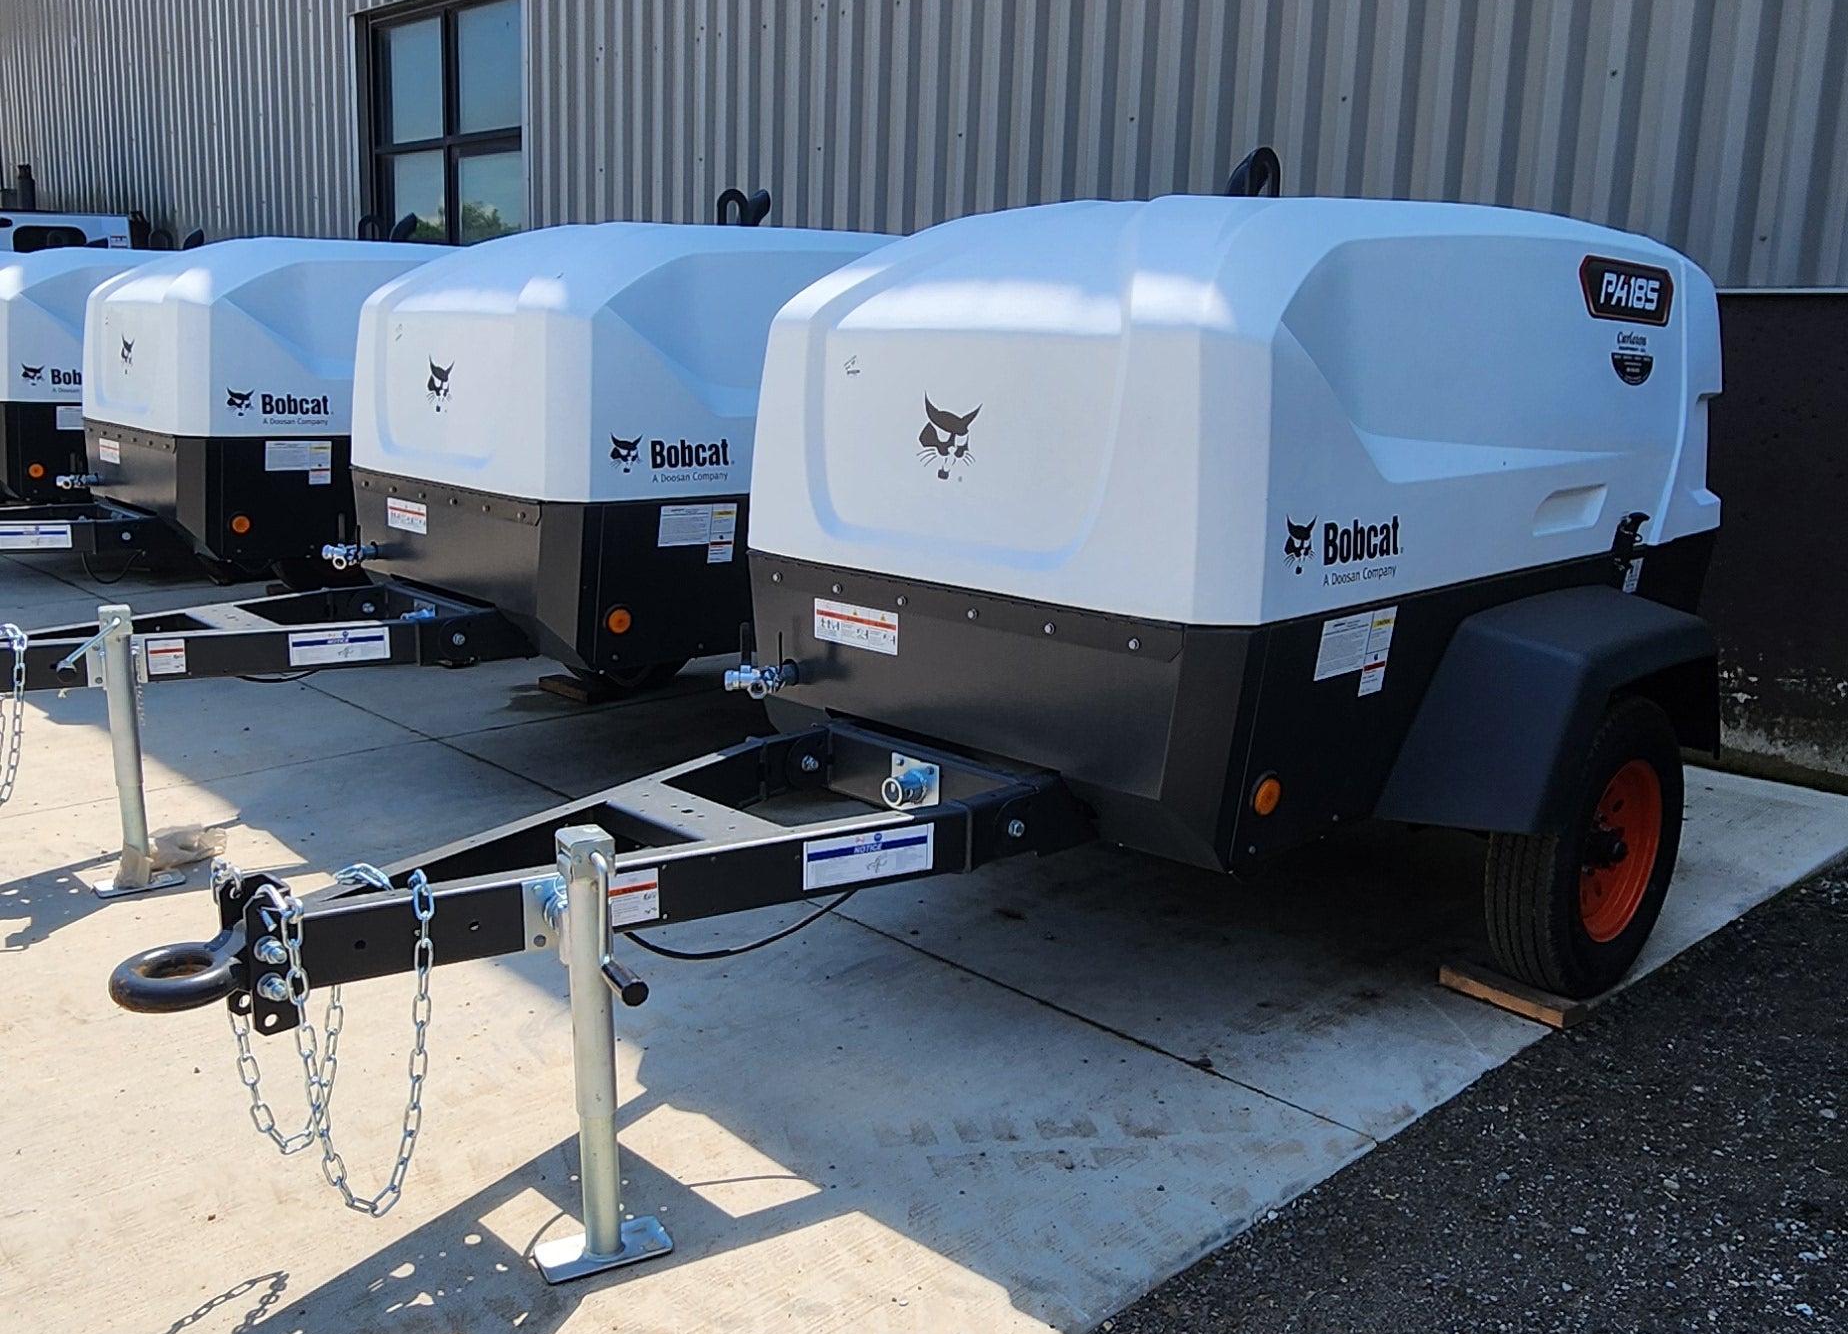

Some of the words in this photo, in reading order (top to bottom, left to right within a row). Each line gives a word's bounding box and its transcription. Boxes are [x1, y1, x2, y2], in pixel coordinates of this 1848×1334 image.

[50, 368, 82, 386] Bob
[261, 393, 330, 416] Bobcat
[650, 438, 730, 469] Bobcat
[652, 474, 659, 484] A
[660, 473, 691, 483] Doosan
[692, 471, 729, 482] Company
[1323, 514, 1400, 566] Bobcat
[1323, 574, 1330, 586] A
[1331, 570, 1361, 586] Doosan
[1362, 565, 1398, 581] Company
[853, 842, 883, 855] NOTICE
